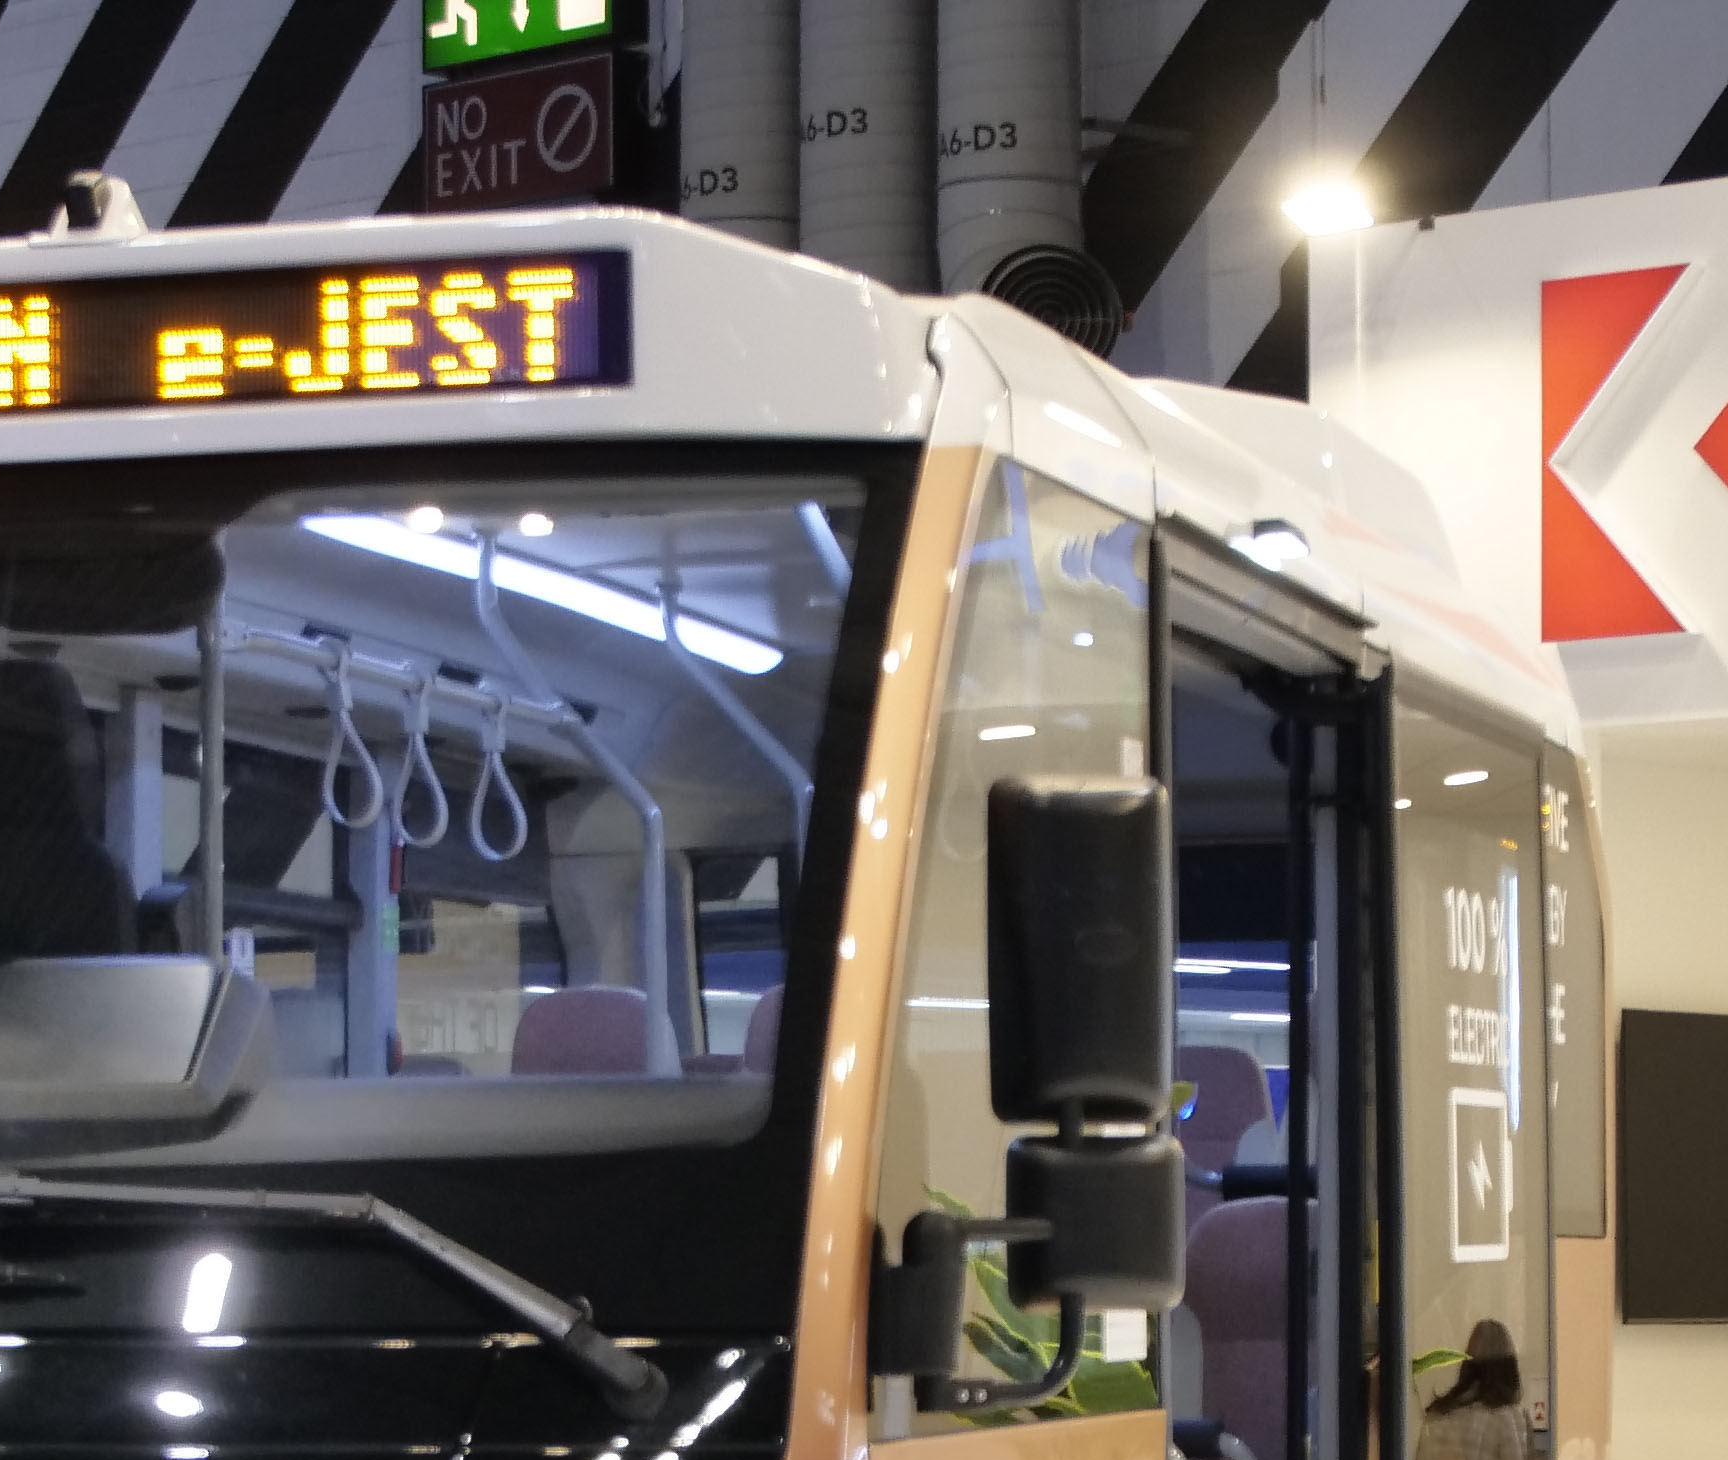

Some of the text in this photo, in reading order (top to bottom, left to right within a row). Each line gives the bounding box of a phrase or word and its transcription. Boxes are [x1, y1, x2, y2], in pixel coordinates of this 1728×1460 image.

[437, 96, 487, 147] NO
[436, 139, 526, 198] EXIT
[155, 266, 575, 400] e-JEST
[1443, 886, 1486, 975] 100
